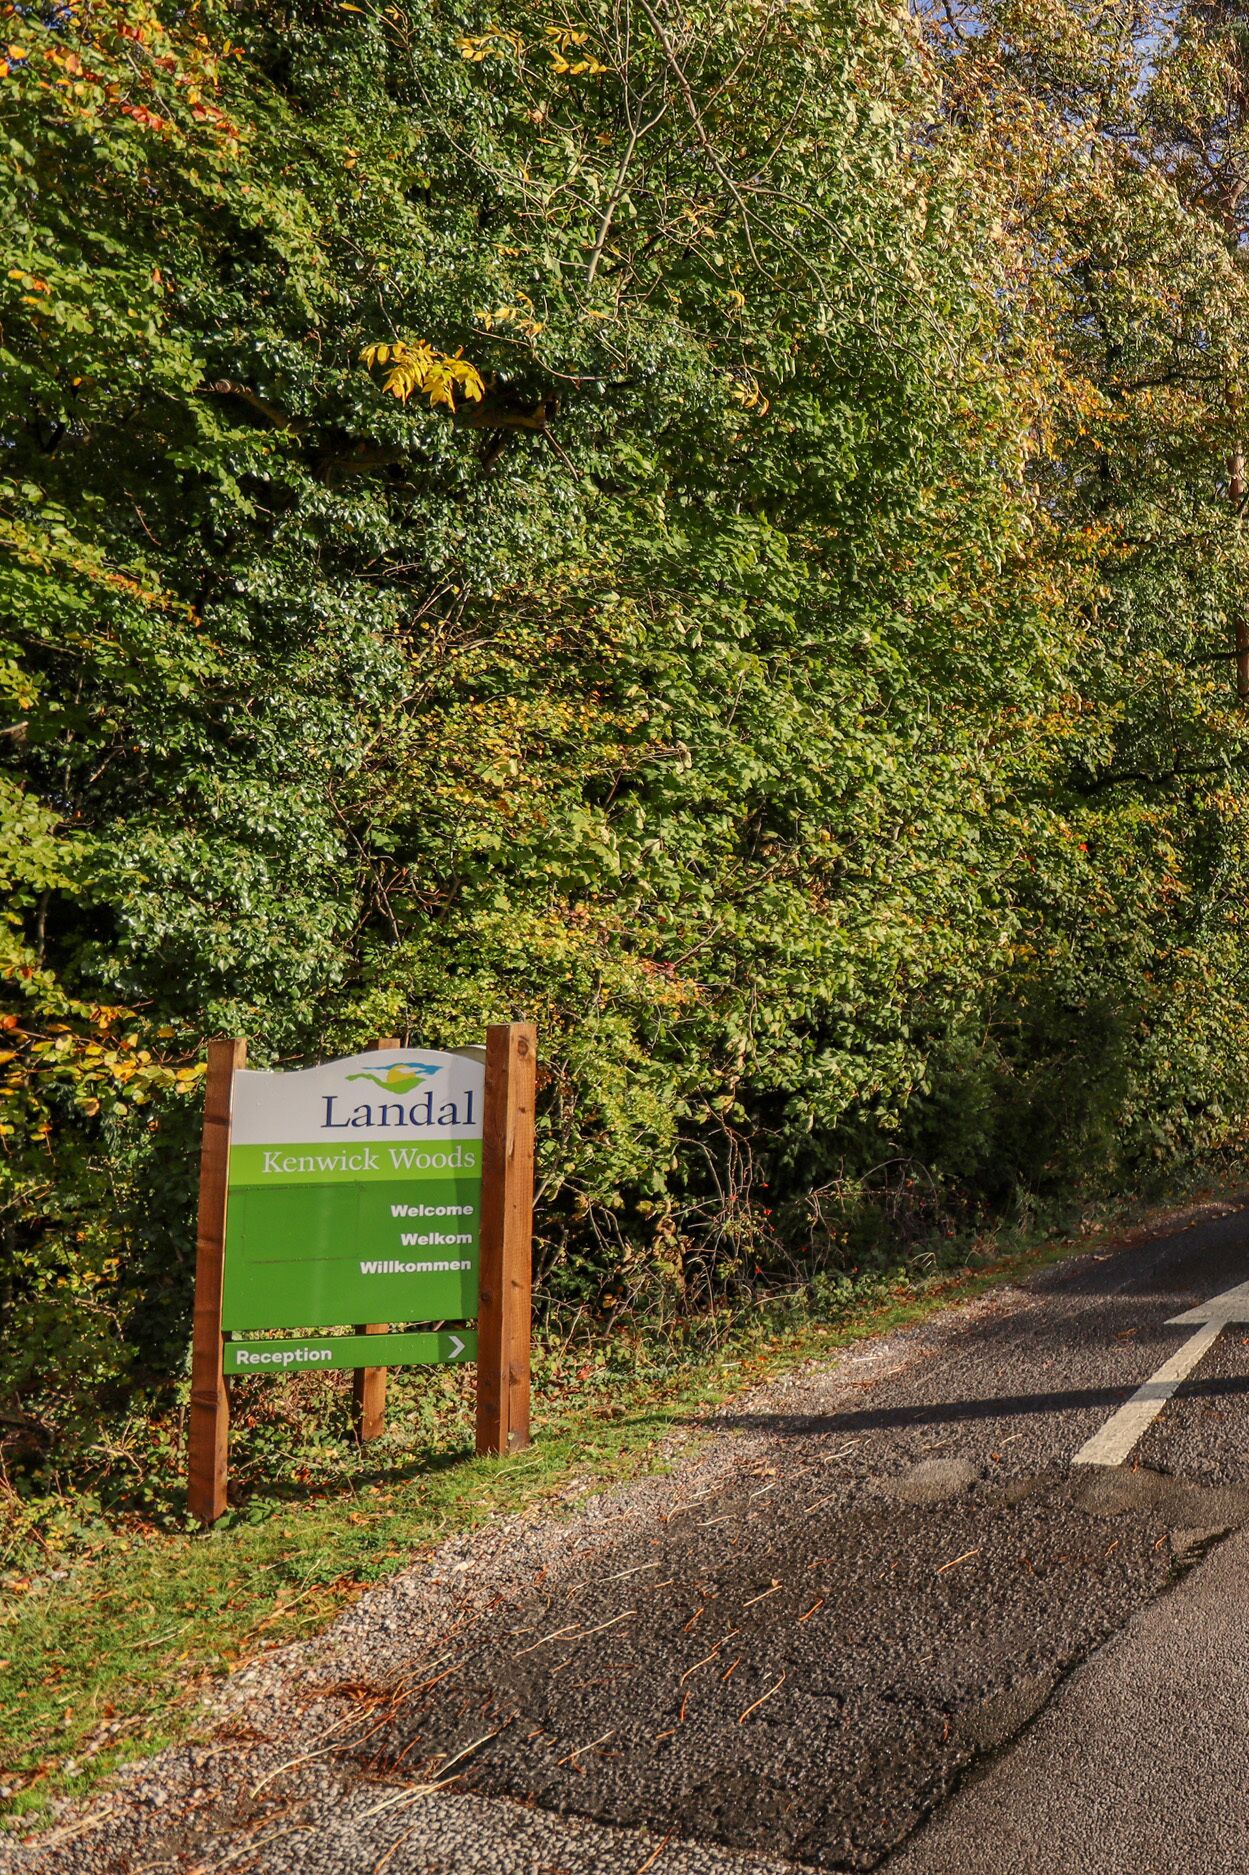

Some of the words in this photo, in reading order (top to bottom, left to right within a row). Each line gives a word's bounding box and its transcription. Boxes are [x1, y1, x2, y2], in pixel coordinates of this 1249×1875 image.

[321, 1090, 476, 1128] Landal
[262, 1148, 379, 1174] Kenwick
[388, 1146, 476, 1169] Woods
[390, 1204, 474, 1218] Welcome
[400, 1232, 473, 1246] Welkom
[360, 1259, 472, 1275] Willkommen
[236, 1347, 332, 1367] Reception
